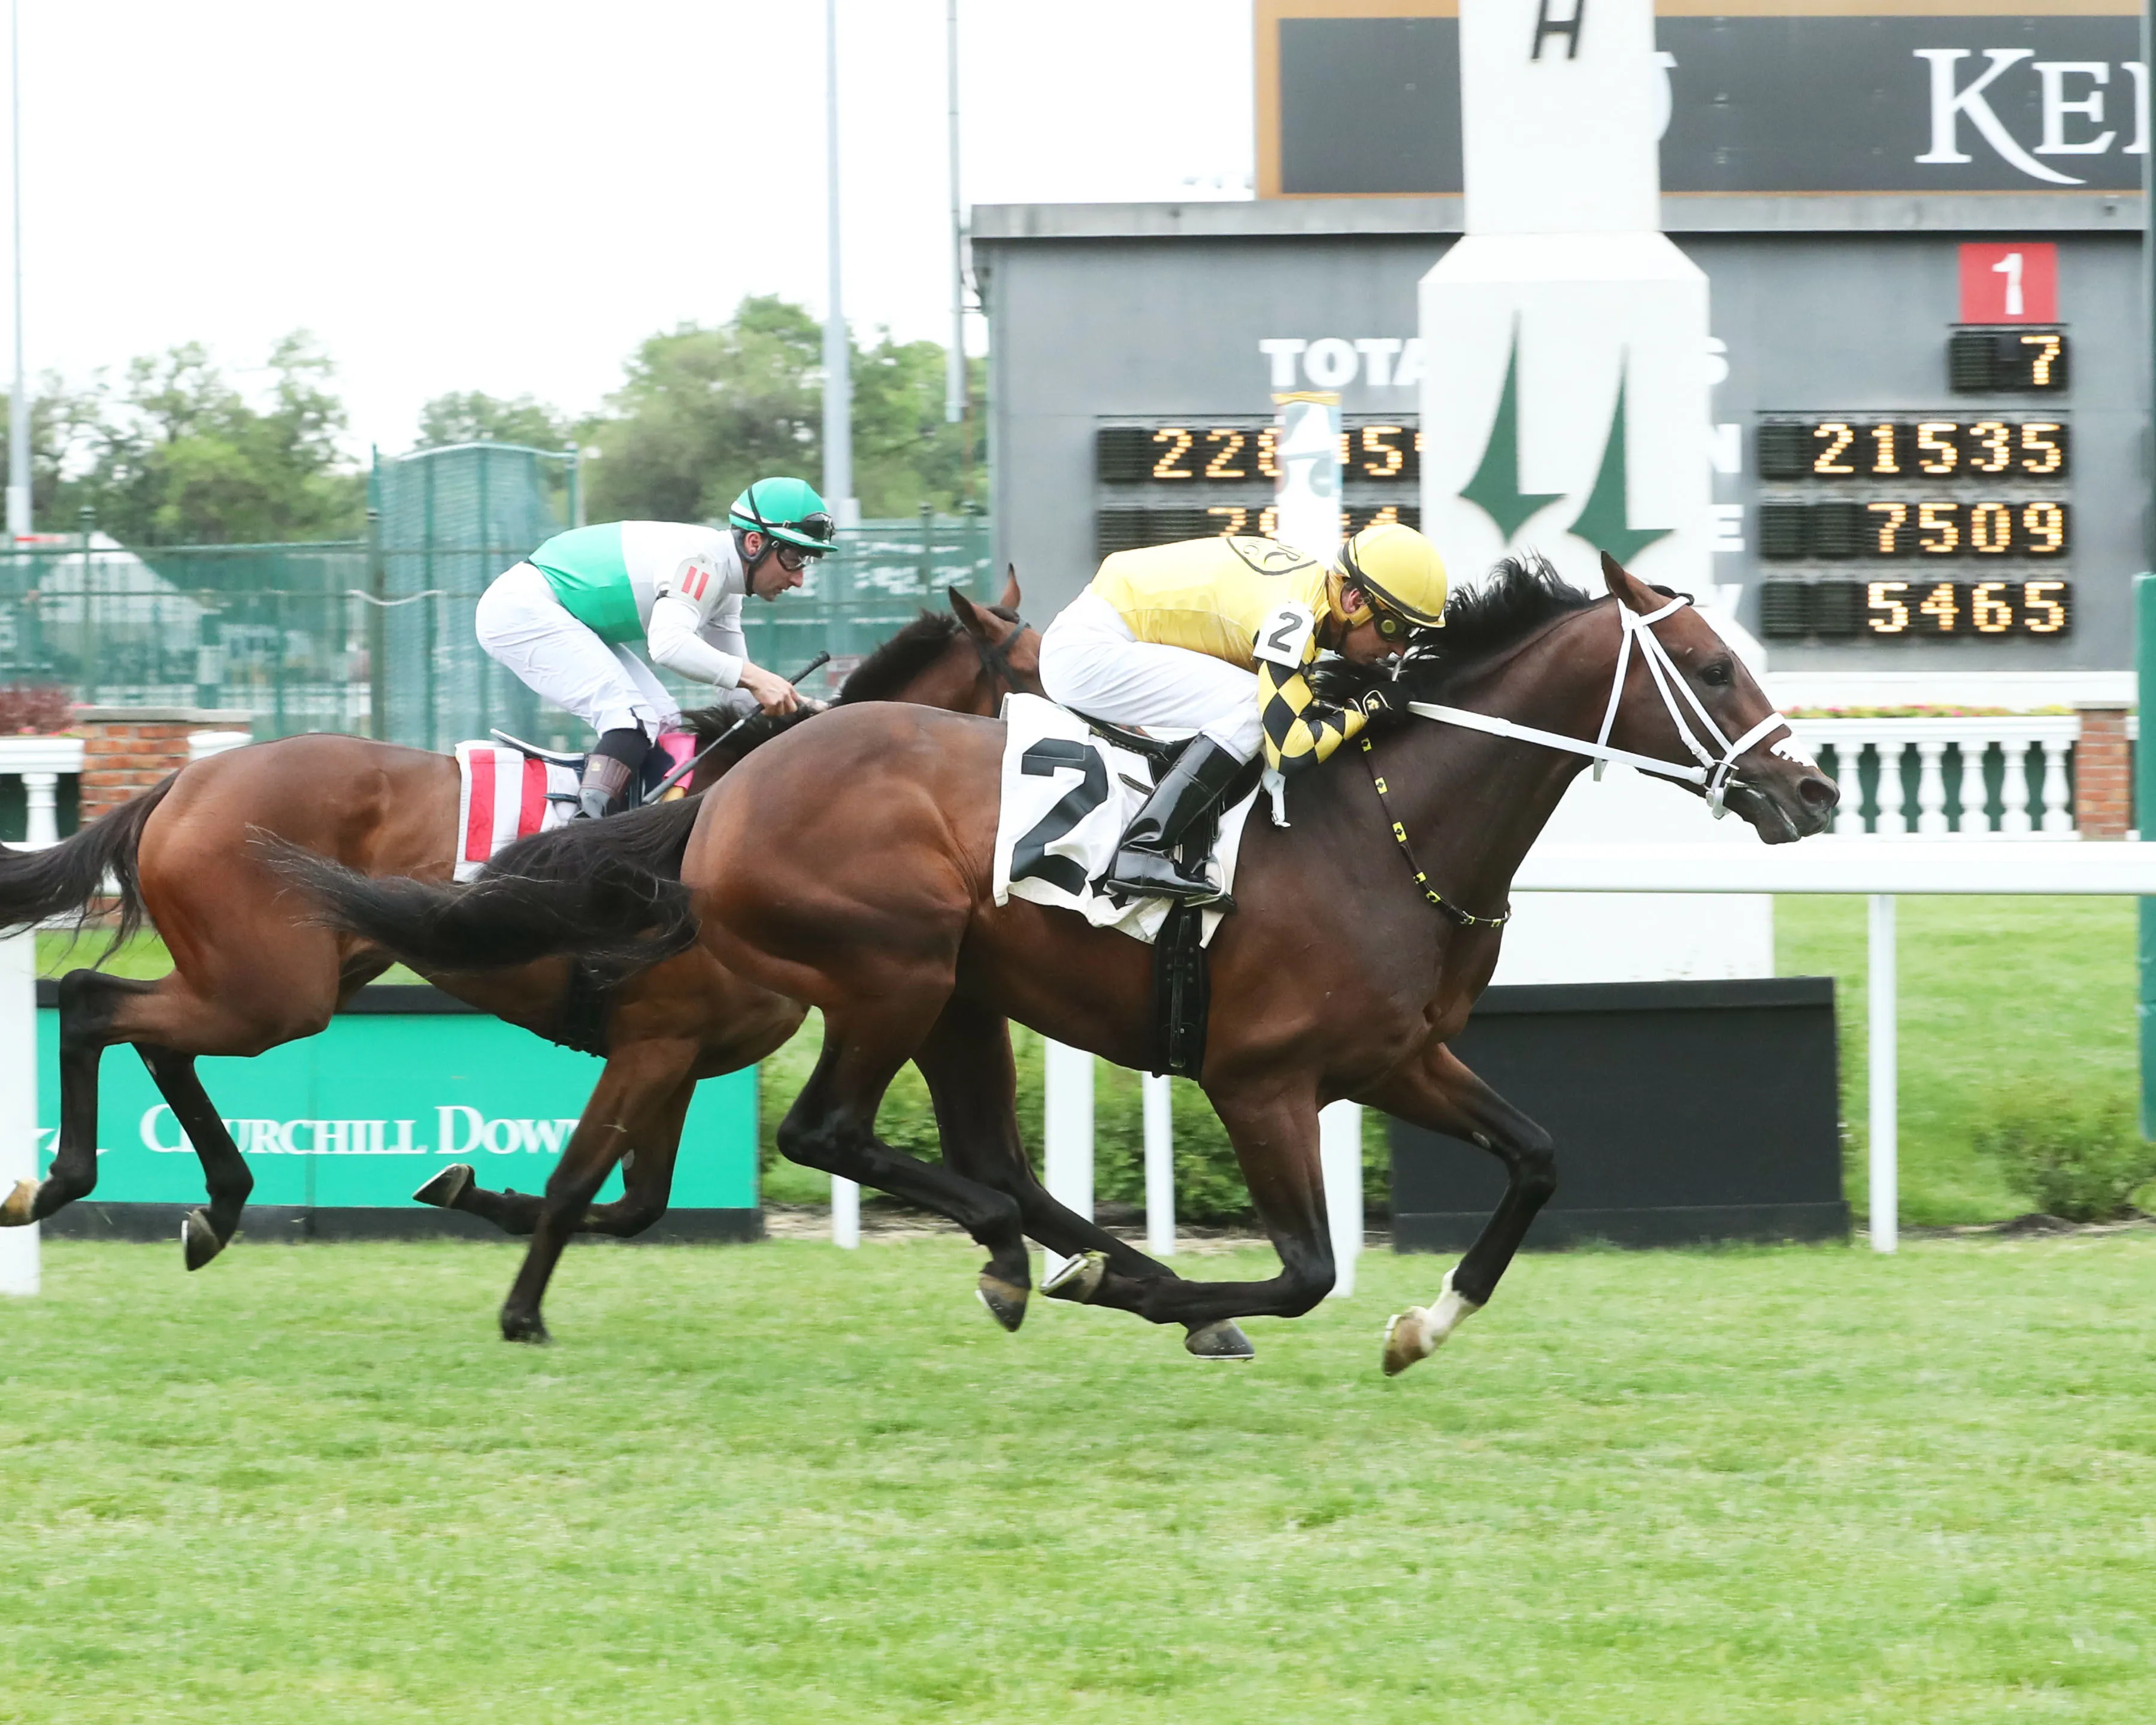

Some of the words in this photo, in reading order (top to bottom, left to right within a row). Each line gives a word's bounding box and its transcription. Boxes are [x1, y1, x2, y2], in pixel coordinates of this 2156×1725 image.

[1531, 0, 1584, 60] H
[1992, 253, 2024, 315] 1
[1259, 338, 1427, 387] TOTA
[2020, 335, 2061, 385] 7
[1813, 420, 2061, 473] 21535
[1867, 502, 2063, 552] 7509
[1867, 582, 2064, 632] 5465
[1267, 612, 1303, 653] 2
[1010, 737, 1112, 897] 2
[434, 1105, 580, 1154] DOW
